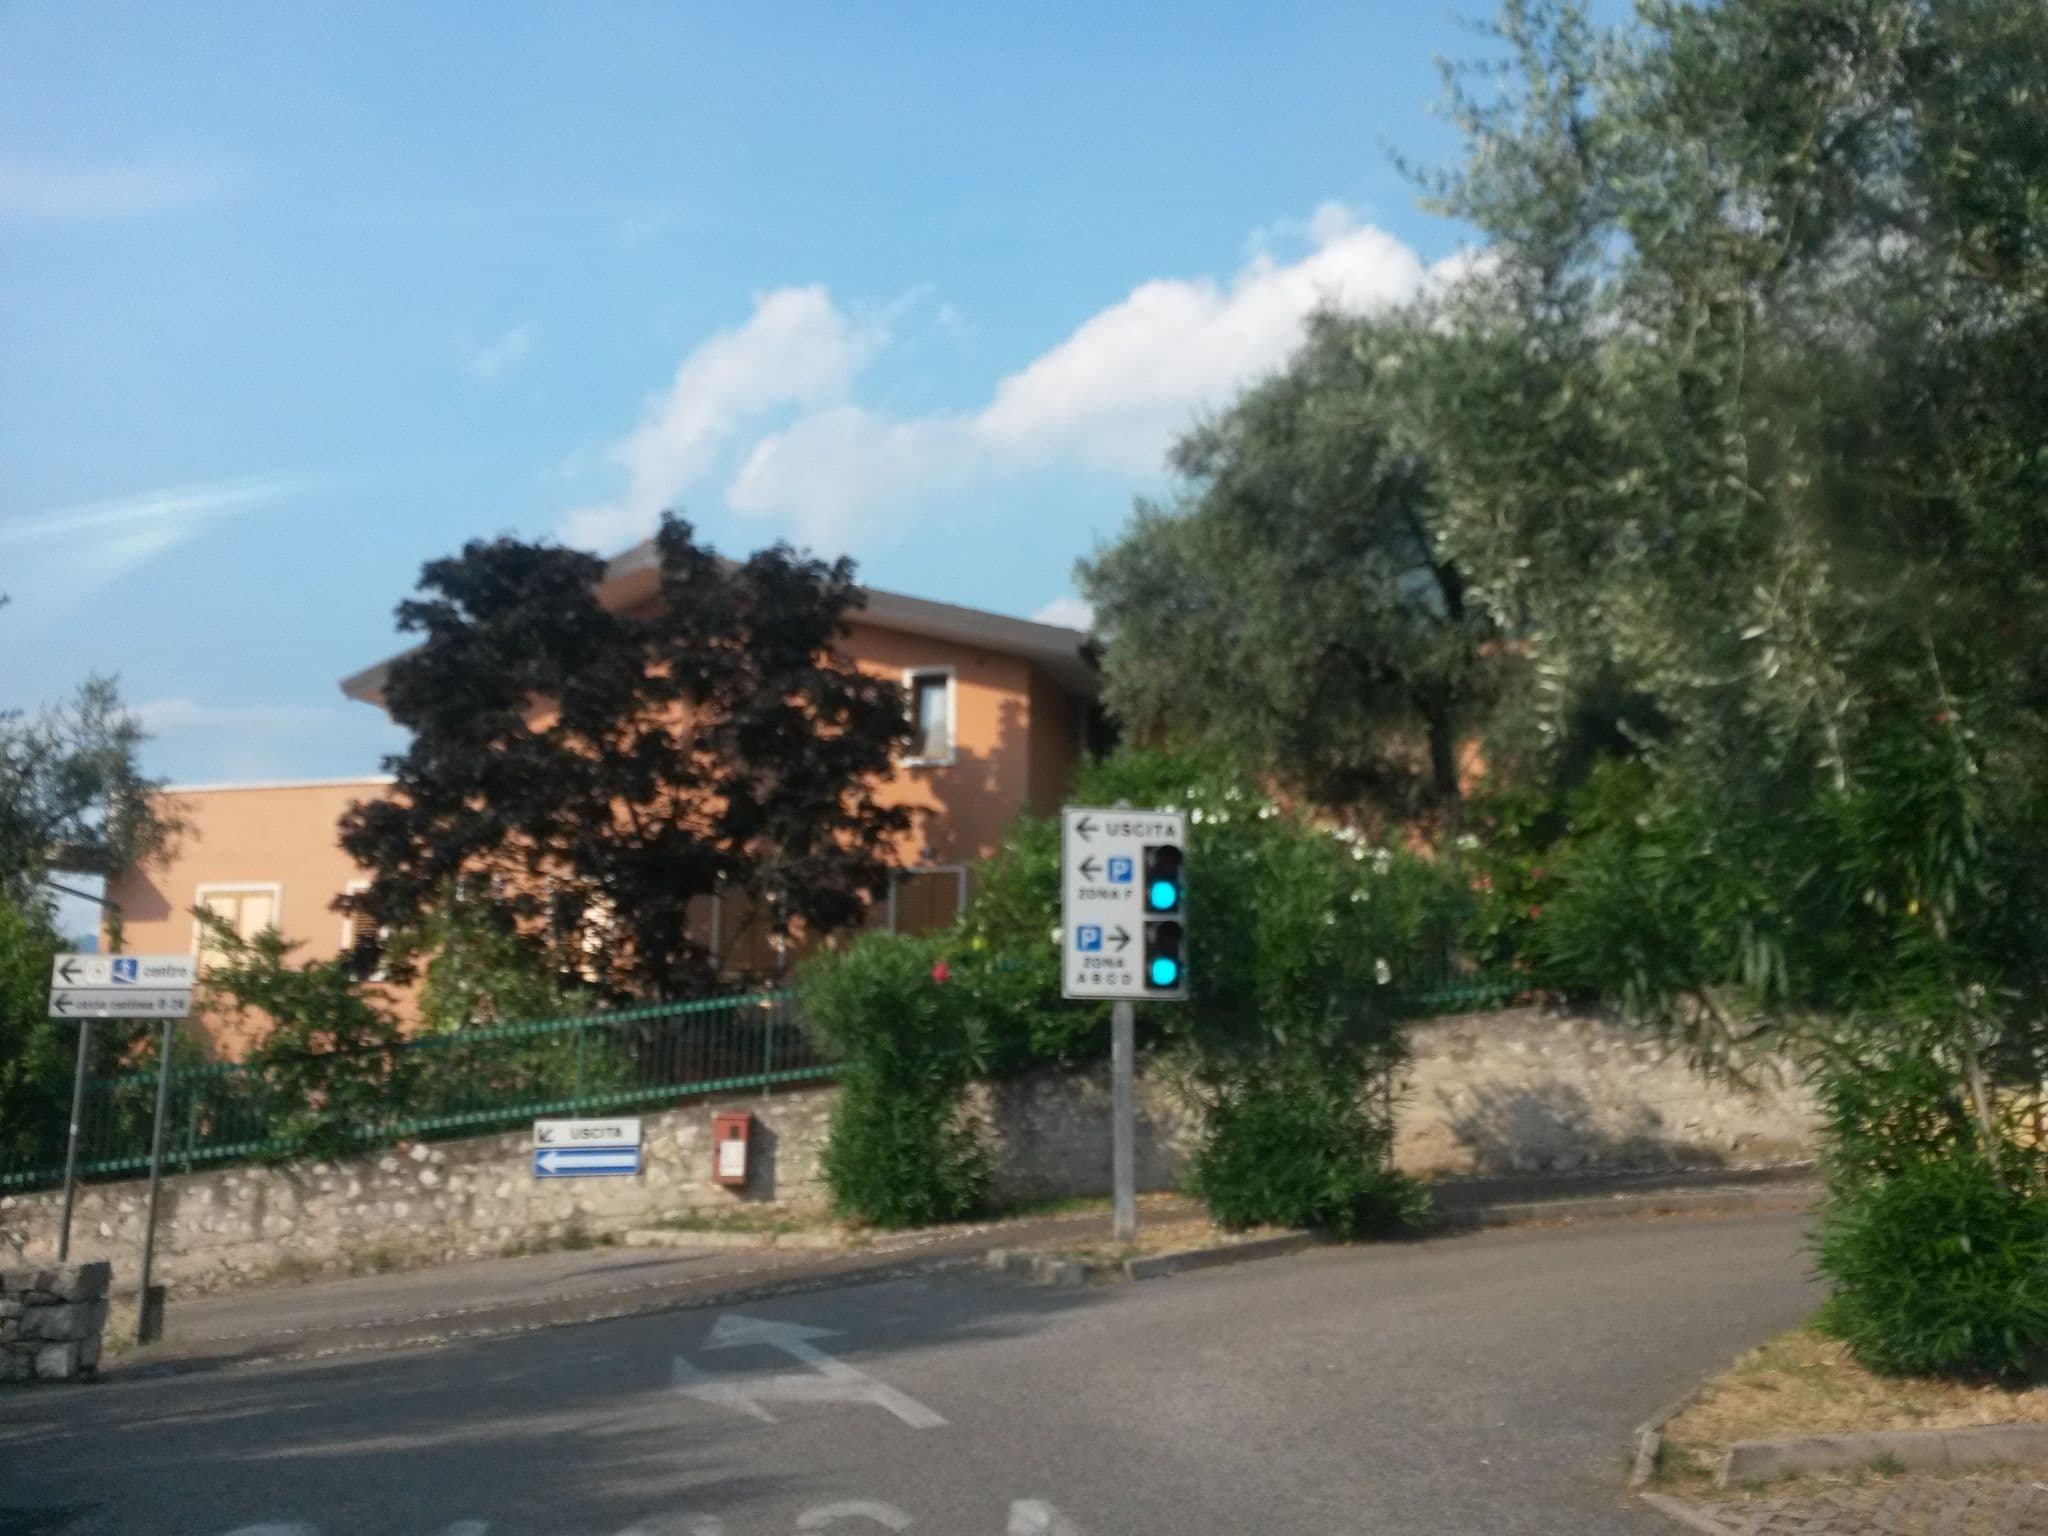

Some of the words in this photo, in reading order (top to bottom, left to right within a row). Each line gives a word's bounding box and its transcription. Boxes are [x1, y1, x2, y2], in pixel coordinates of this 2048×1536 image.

[1105, 823, 1175, 837] USCITA
[1111, 860, 1130, 882] P
[1078, 888, 1119, 900] ZONA
[1080, 929, 1099, 950] P
[1083, 957, 1124, 969] ZONA
[570, 1126, 622, 1139] USCITA
